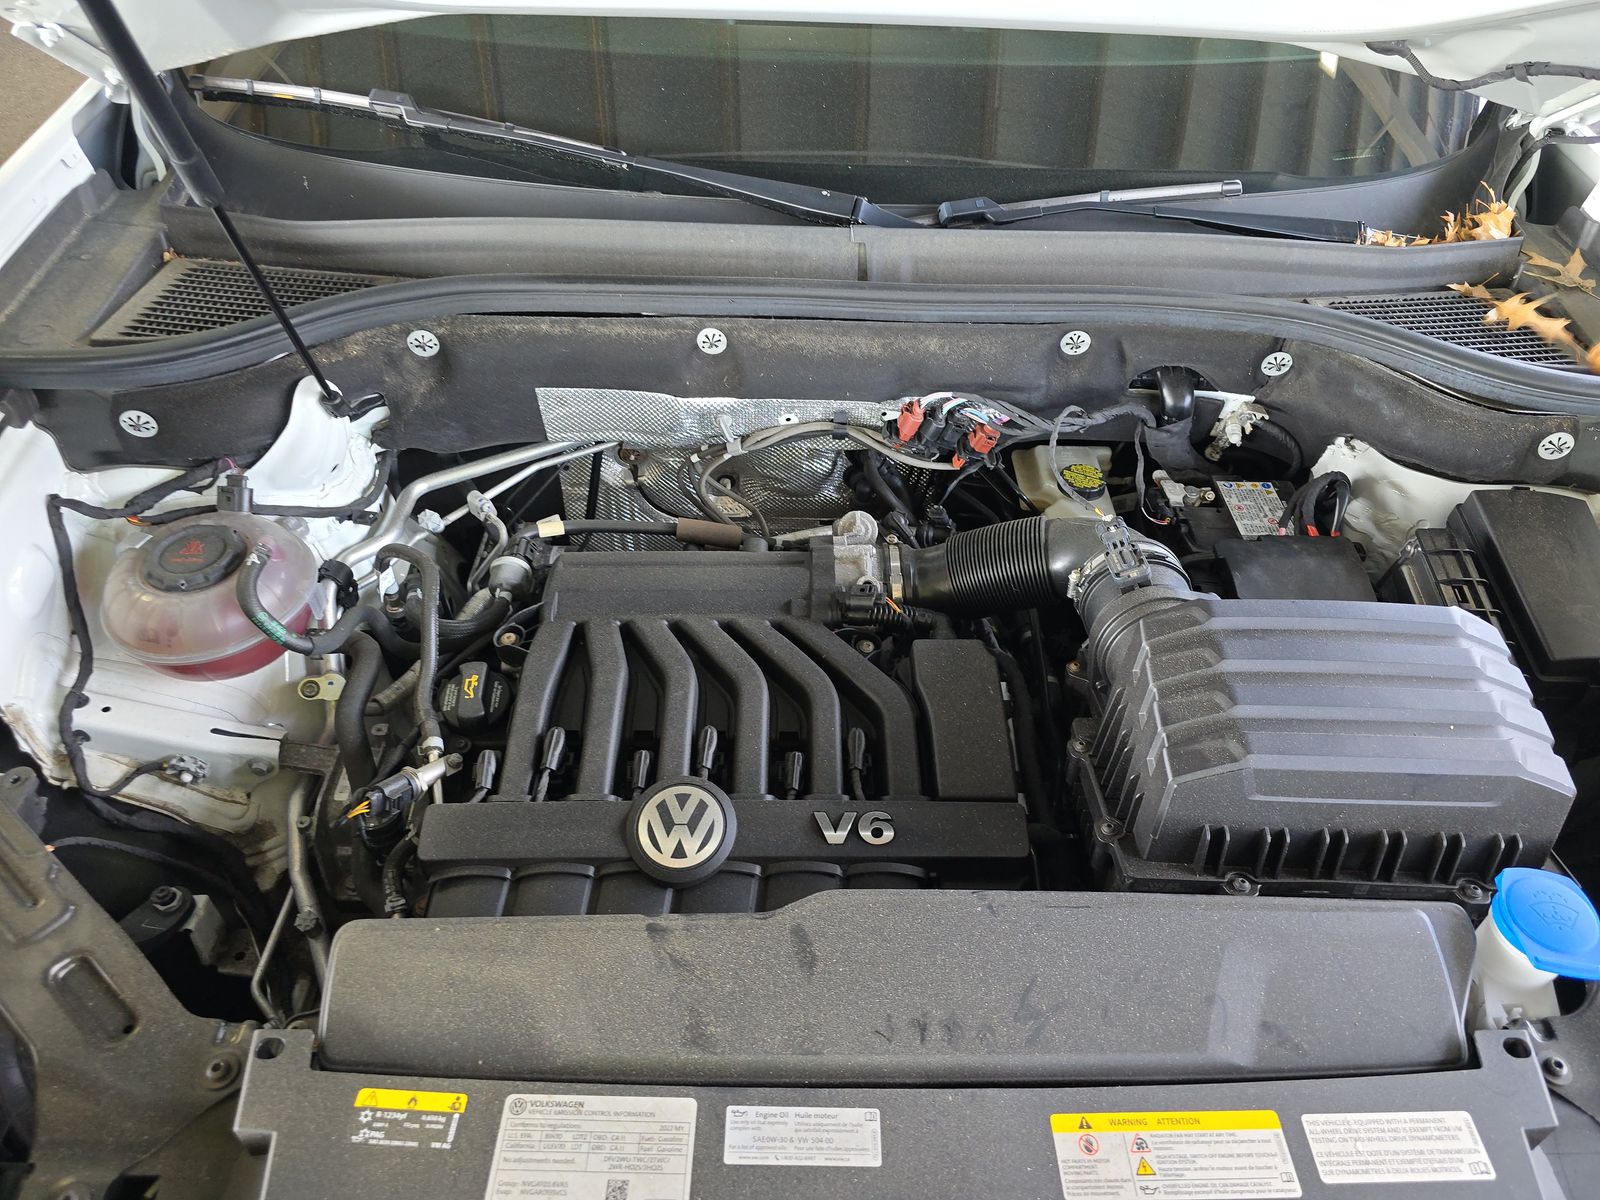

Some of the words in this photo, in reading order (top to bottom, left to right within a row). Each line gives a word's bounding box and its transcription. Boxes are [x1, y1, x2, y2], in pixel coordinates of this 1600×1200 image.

[813, 811, 895, 845] V6
[529, 1100, 585, 1108] VOLKSWAGEN
[1108, 1118, 1148, 1126] WARNING
[1156, 1117, 1201, 1125] ATTENTION
